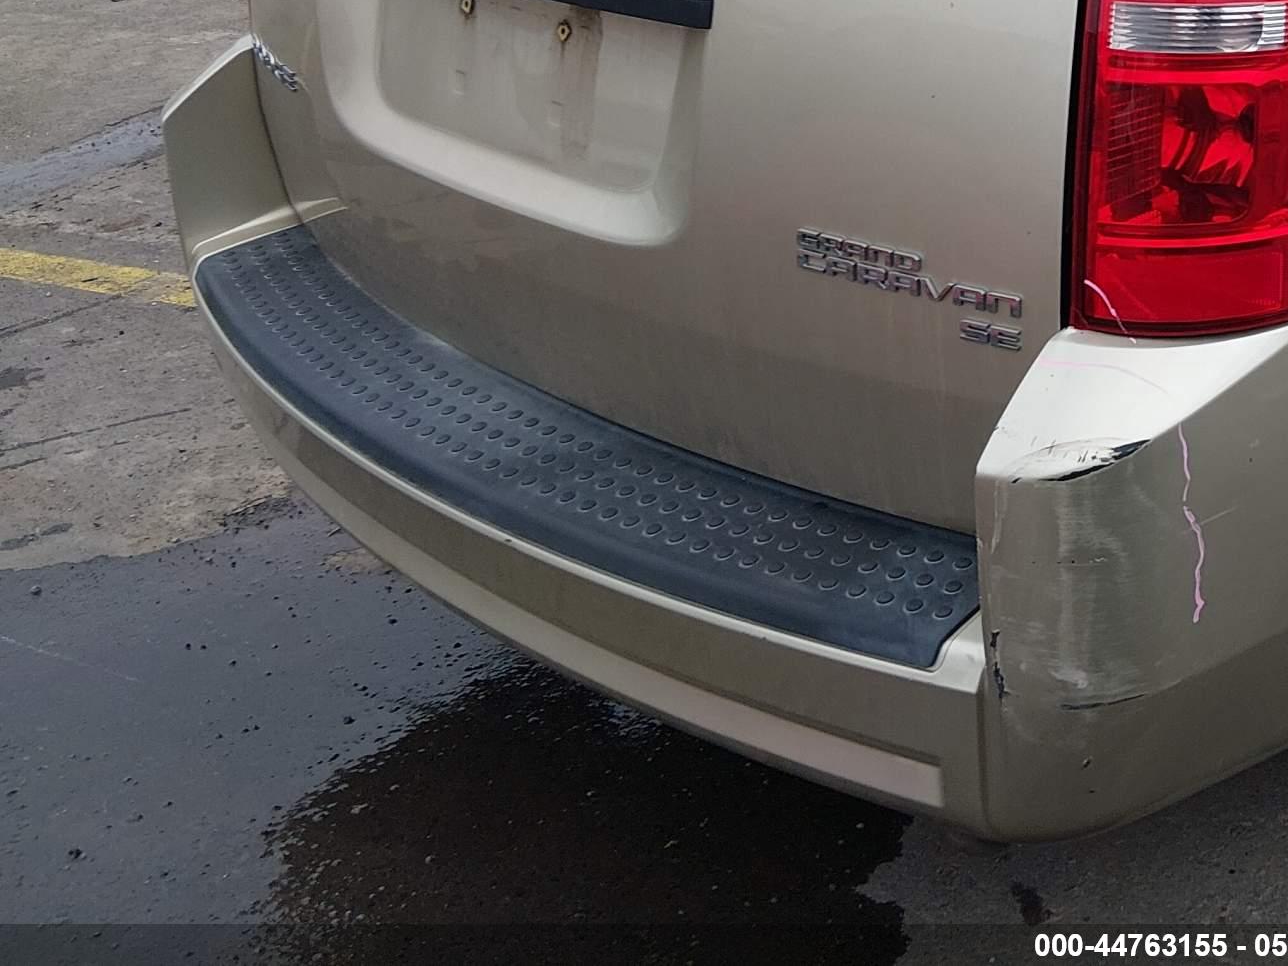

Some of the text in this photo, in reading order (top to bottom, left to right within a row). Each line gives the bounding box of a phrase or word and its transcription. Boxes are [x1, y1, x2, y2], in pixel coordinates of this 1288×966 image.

[797, 228, 923, 273] GRAND
[797, 248, 1023, 318] CARAVAN
[959, 318, 1022, 351] SE
